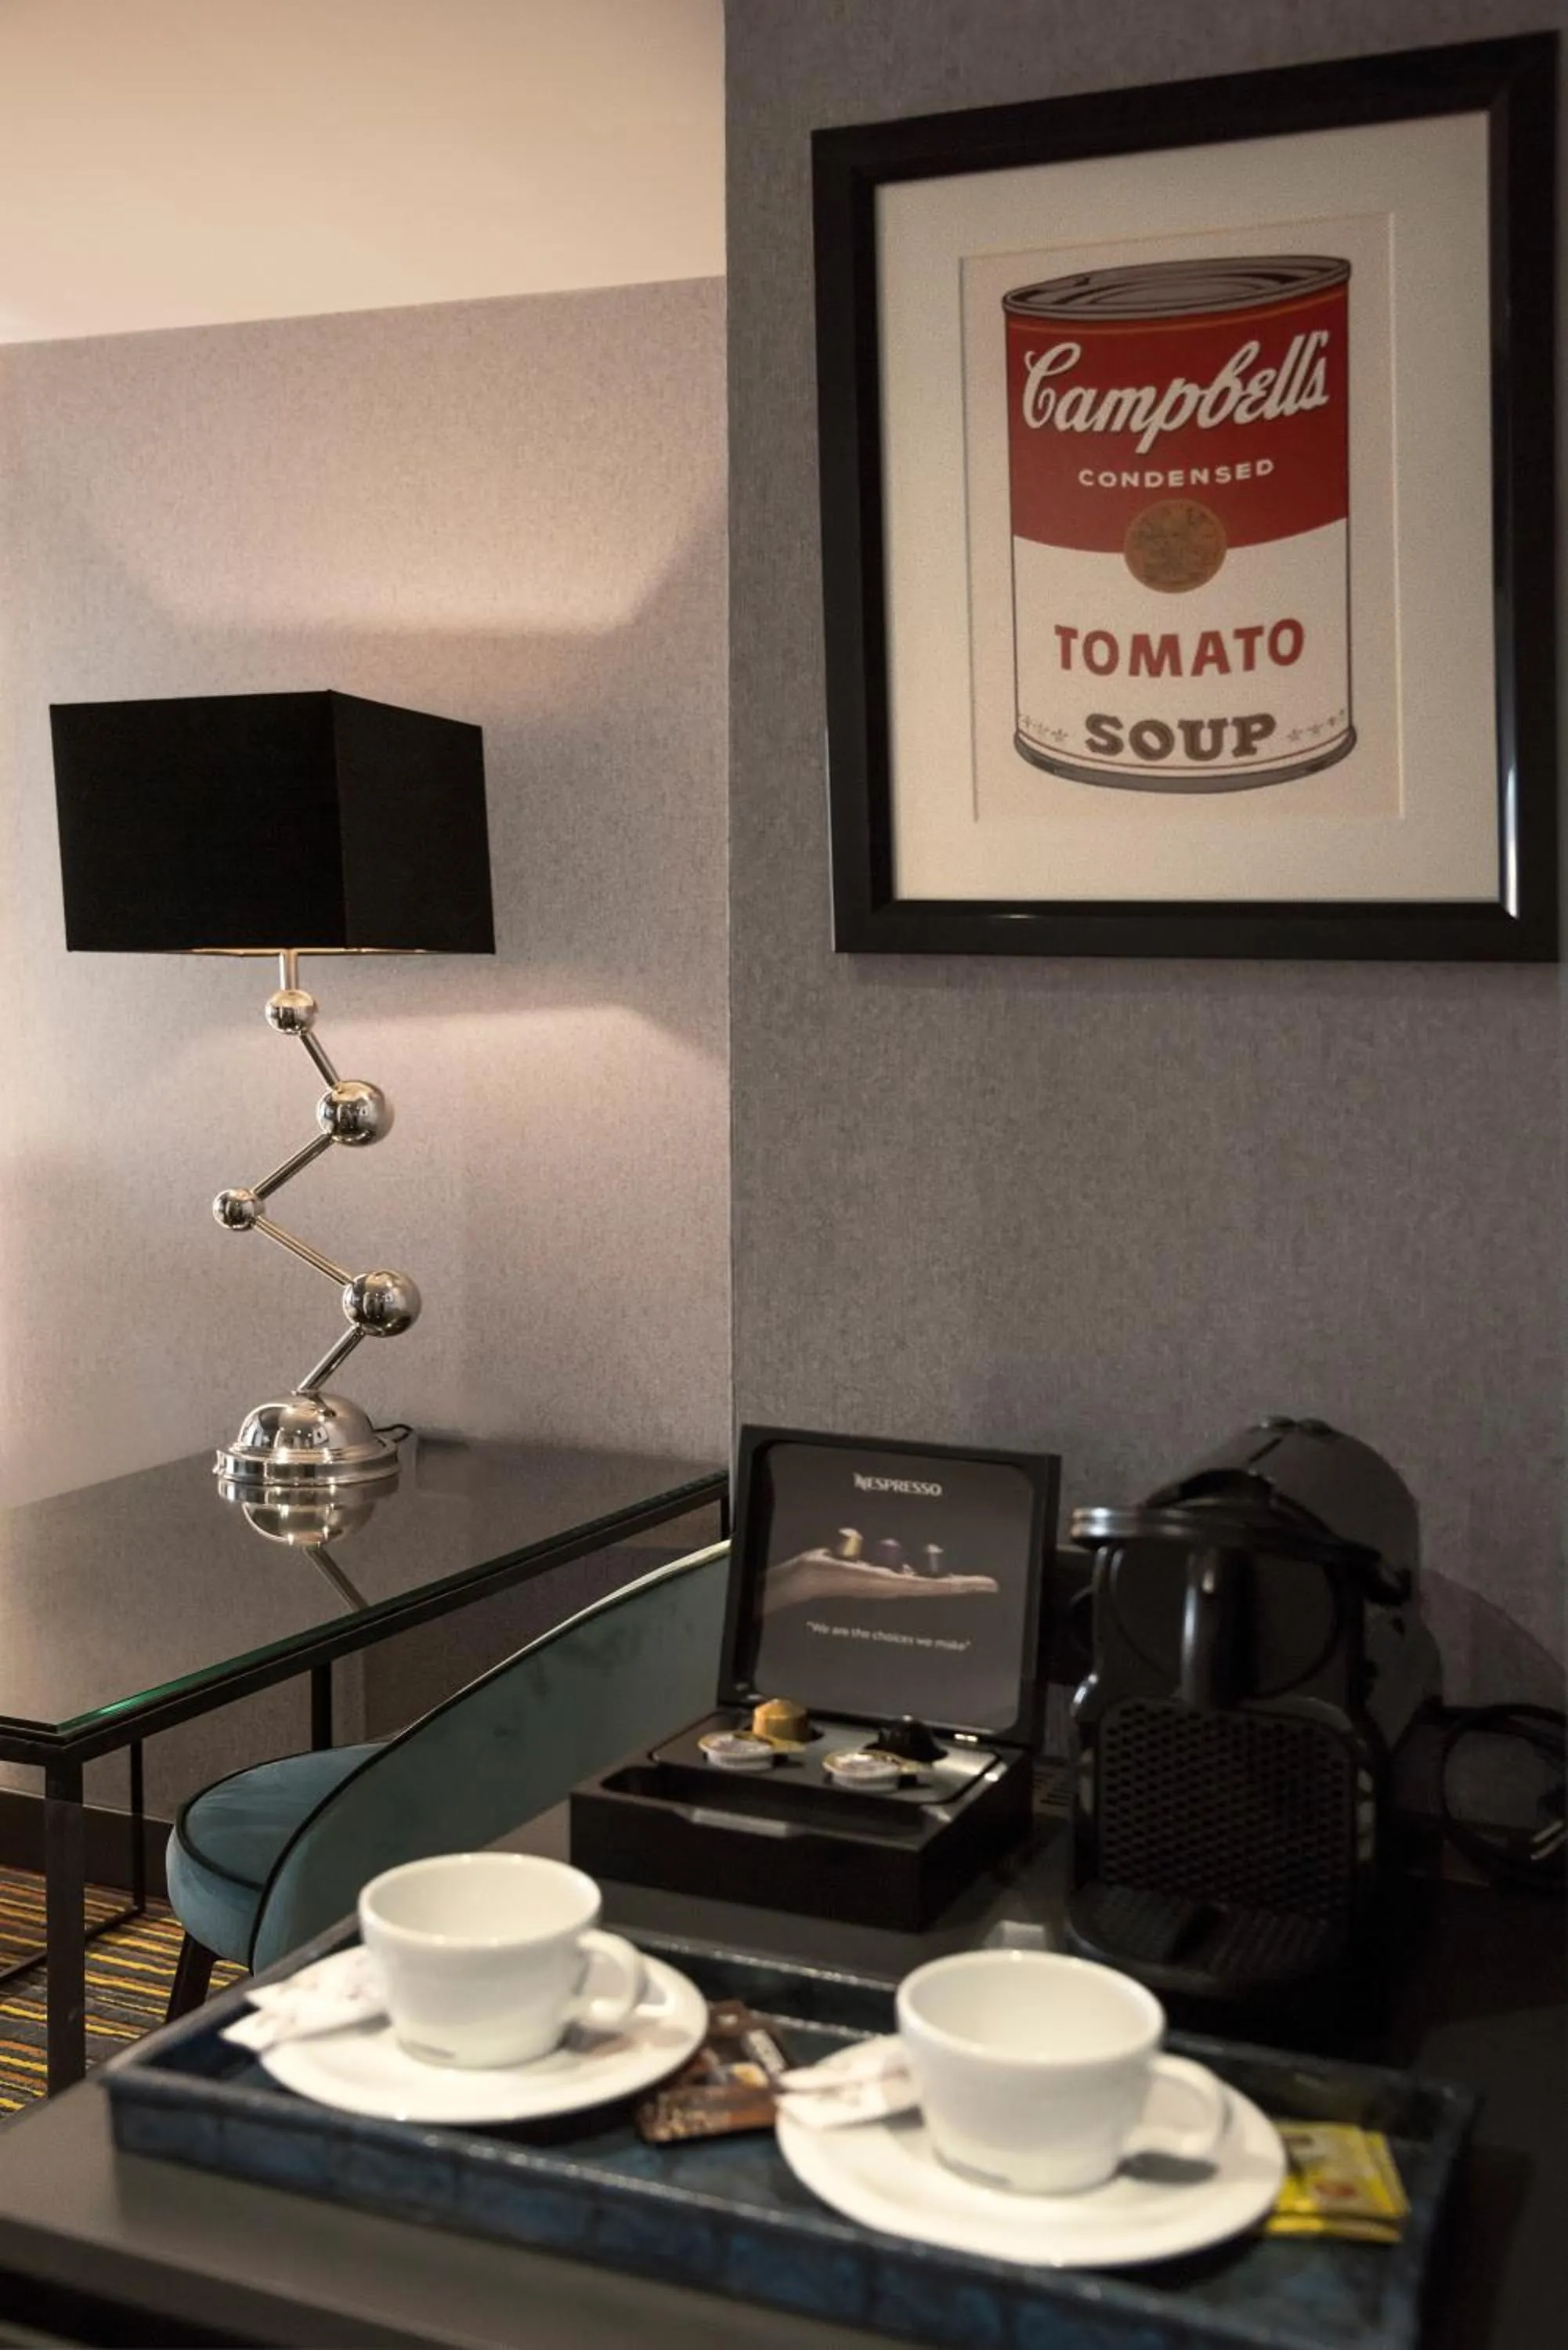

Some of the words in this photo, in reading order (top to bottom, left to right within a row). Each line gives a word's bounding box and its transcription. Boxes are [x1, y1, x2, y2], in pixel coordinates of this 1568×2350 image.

[1023, 330, 1329, 454] Campbell's
[1078, 458, 1274, 488] CONDENSED
[1054, 618, 1306, 678] TOMATO
[1084, 712, 1277, 761] SOUP
[852, 1473, 942, 1496] NESPRESSO
[832, 1626, 850, 1636] are
[851, 1628, 870, 1640] the
[872, 1630, 914, 1643] choices
[916, 1638, 933, 1647] we
